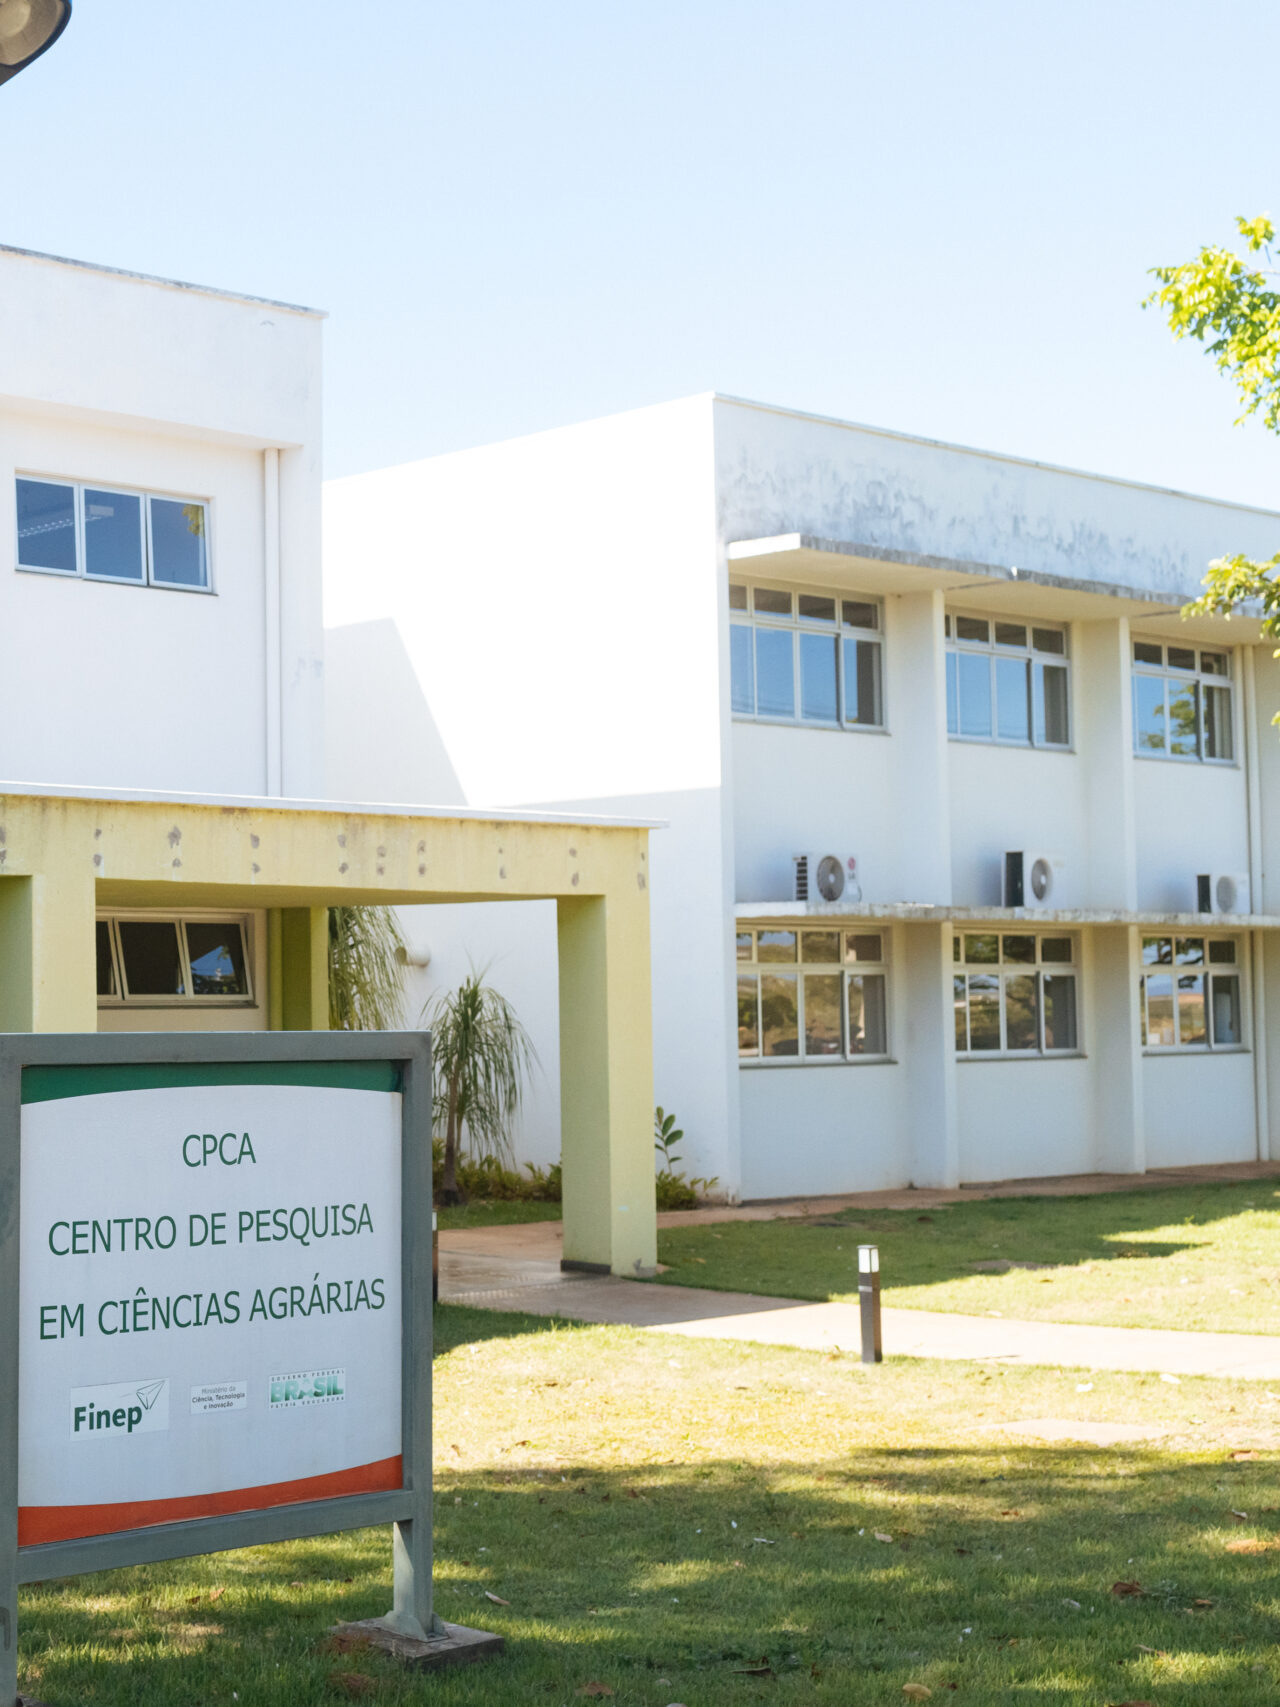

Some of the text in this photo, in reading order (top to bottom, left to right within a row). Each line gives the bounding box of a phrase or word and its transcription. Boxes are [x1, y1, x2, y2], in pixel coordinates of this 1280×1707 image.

[183, 1133, 256, 1167] CPCA
[49, 1203, 373, 1256] CENTRO DE PESQUISA
[40, 1273, 385, 1340] EM CIÊNCIAS AGRÁRIAS
[271, 1375, 344, 1403] BRASIL
[73, 1403, 143, 1433] Finep
